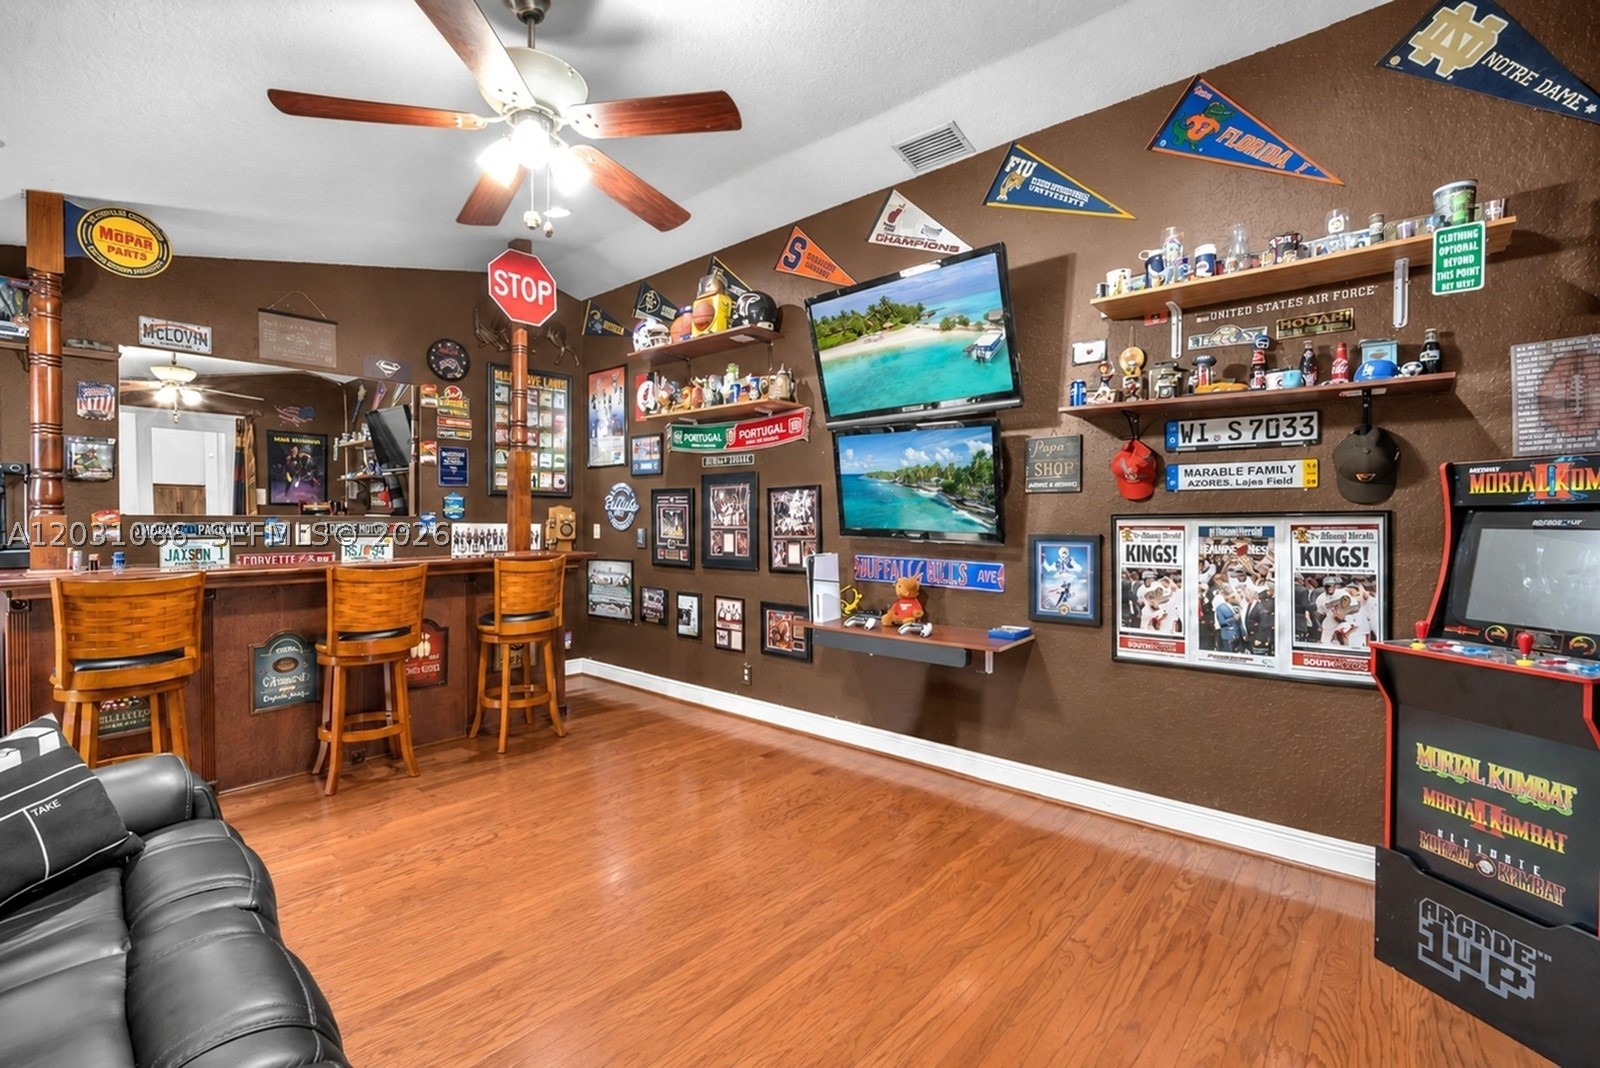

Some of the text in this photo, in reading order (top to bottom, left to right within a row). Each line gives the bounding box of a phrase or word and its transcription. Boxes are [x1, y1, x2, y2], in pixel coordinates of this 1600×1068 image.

[1481, 51, 1589, 111] NOTRE DAME
[1215, 126, 1293, 169] FLORIDA
[1004, 155, 1038, 178] FIU
[99, 225, 153, 250] MOPAR
[875, 233, 960, 252] CHAMPIONS
[1438, 229, 1478, 244] CLOTHING
[107, 245, 147, 261] PARTS
[782, 236, 807, 270] S
[1438, 241, 1479, 256] OPTIONAL
[1443, 254, 1475, 268] BEYOND
[1437, 266, 1480, 281] THIS POINT
[493, 269, 552, 305] STOP
[1456, 279, 1475, 288] WEST
[1210, 285, 1375, 320] UNITED STATES AIR FORCE
[683, 433, 722, 443] PORTUGAL
[739, 423, 787, 439] PORTUGAL
[1180, 422, 1209, 444] WI
[1249, 415, 1315, 441] 7033
[1030, 440, 1064, 457] Papa
[1034, 461, 1074, 477] SHOP
[1184, 465, 1244, 478] MARABLE
[1247, 464, 1297, 476] FAMILY
[1236, 478, 1263, 487] Lajes
[1266, 477, 1293, 485] Field
[1469, 471, 1550, 494] MORTAL
[164, 547, 211, 561] JAXSON
[243, 554, 296, 565] CORVETTE
[1126, 544, 1178, 564] KINGS!
[1300, 546, 1369, 567] KINGS!
[926, 560, 967, 586] BILLS
[977, 569, 997, 584] AVE
[1416, 742, 1577, 810] MORTAL KOMBAT
[30, 799, 62, 817] TAKE
[1490, 810, 1568, 854] KOMBAT
[1498, 861, 1566, 907] KOMBAT
[1419, 897, 1537, 976] ARCADE
